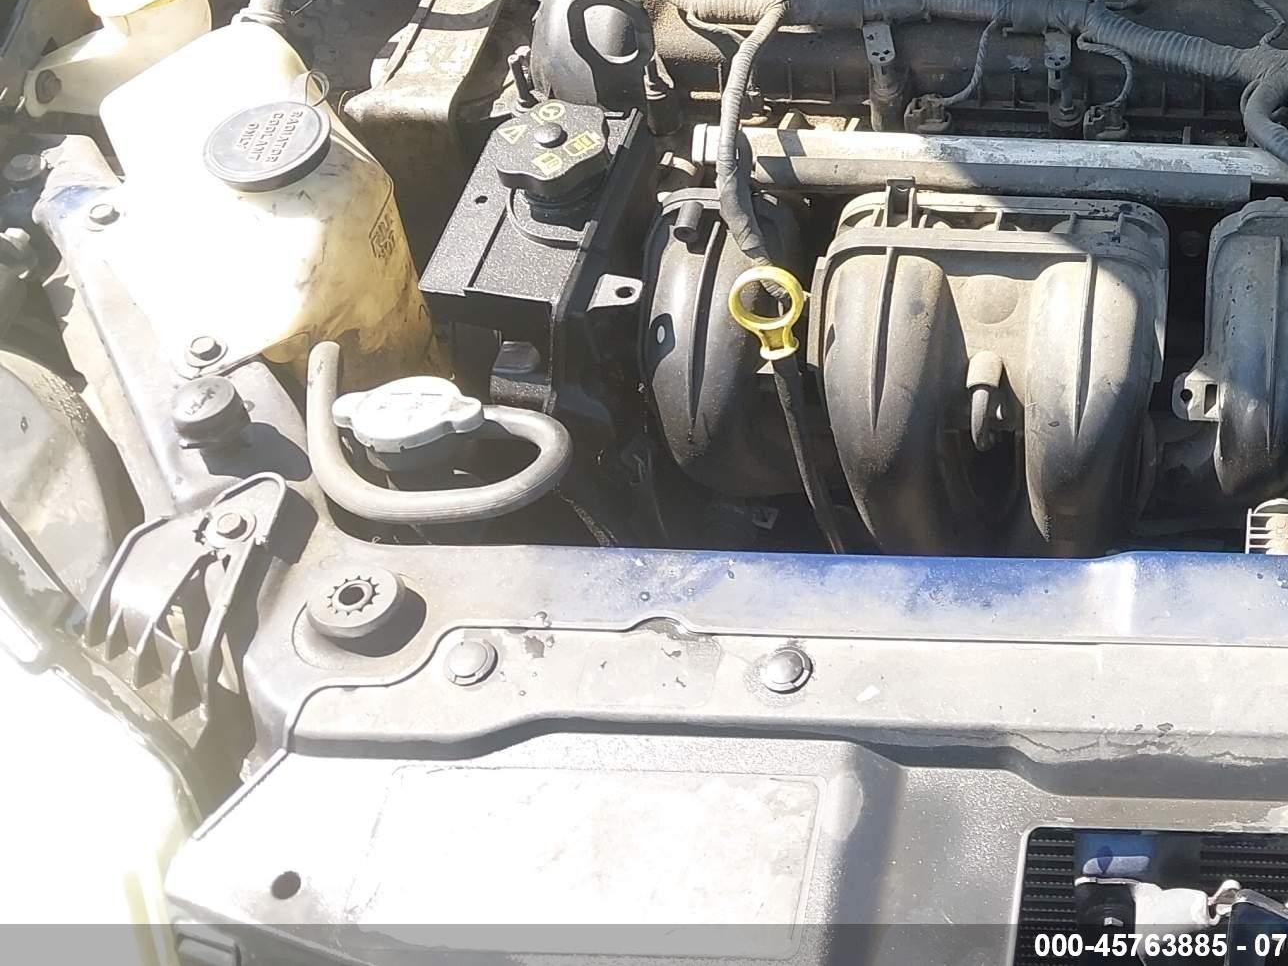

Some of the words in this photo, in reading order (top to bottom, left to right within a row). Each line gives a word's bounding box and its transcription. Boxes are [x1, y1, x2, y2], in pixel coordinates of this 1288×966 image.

[237, 123, 260, 149] ONLY
[250, 113, 284, 161] COOLANT
[266, 111, 304, 162] RADIATOR
